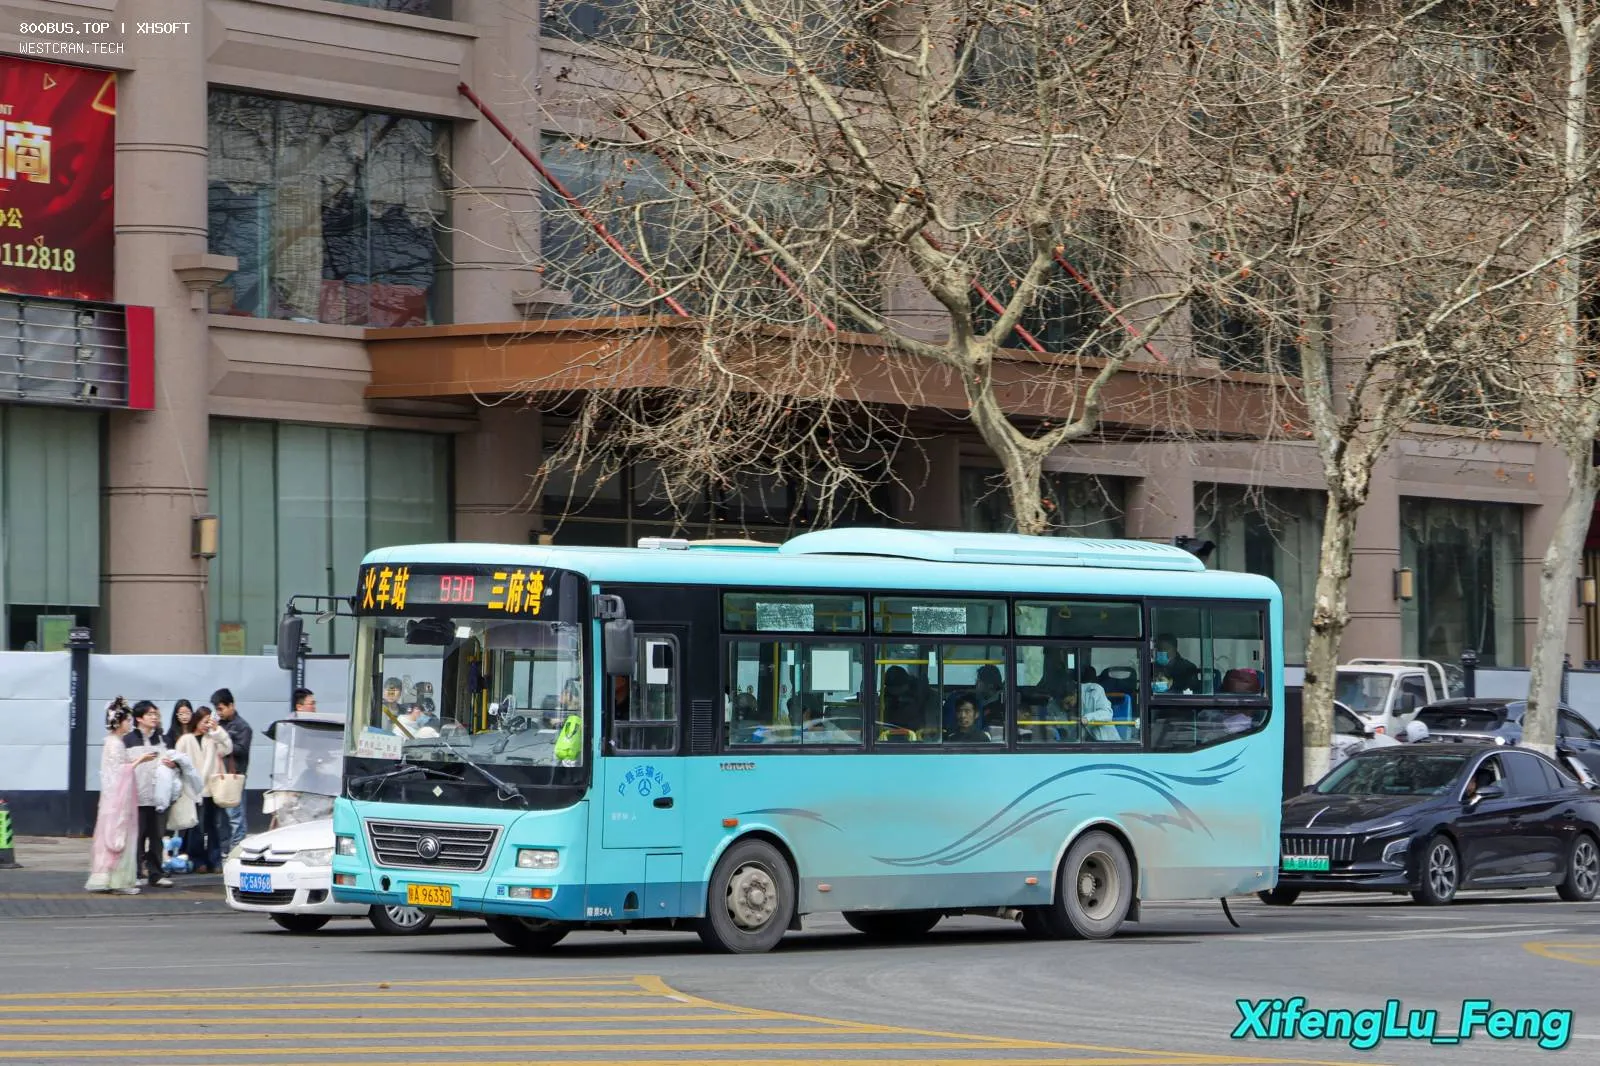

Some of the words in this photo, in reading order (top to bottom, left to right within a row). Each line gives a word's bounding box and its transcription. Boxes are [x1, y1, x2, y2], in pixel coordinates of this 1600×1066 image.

[0, 243, 76, 273] 112818
[362, 566, 409, 610] 火车站
[440, 575, 475, 602] 930
[488, 569, 544, 615] 三府湾
